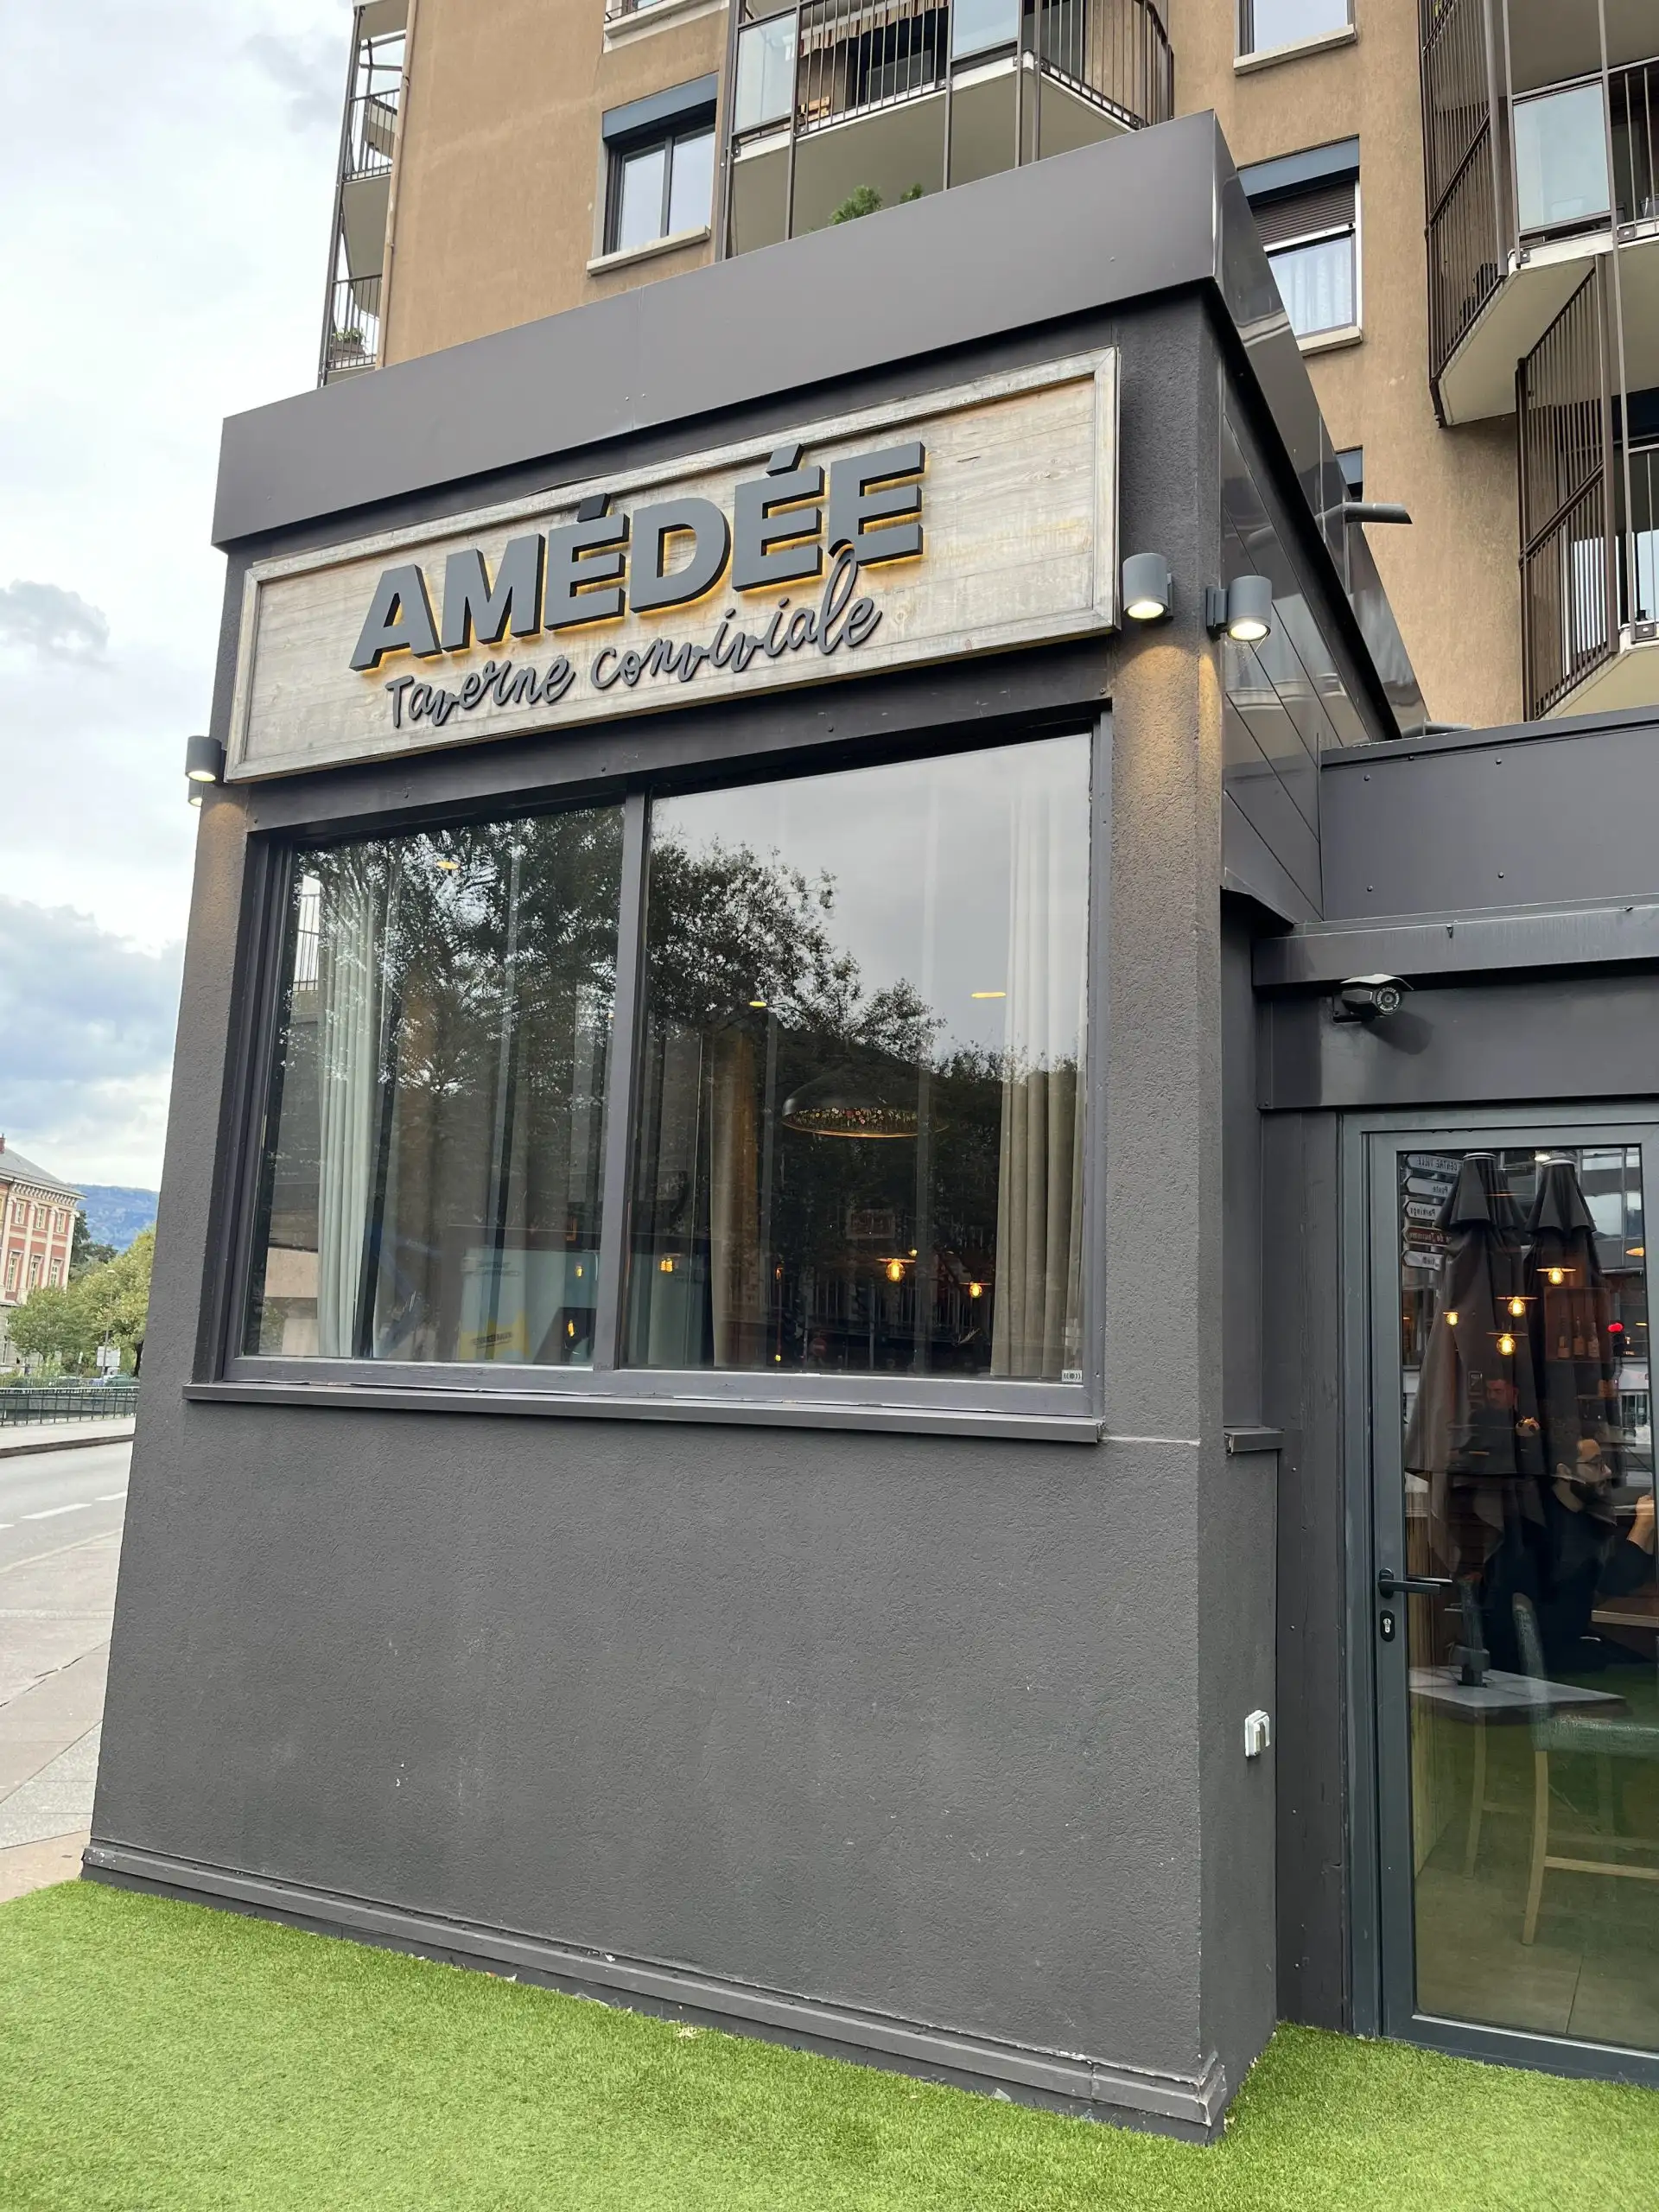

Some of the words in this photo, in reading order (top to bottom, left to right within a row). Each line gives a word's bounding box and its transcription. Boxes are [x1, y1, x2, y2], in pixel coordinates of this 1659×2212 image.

[349, 442, 925, 672] AMÉDÉE
[385, 654, 576, 728] Taverne
[590, 548, 883, 690] conviviale
